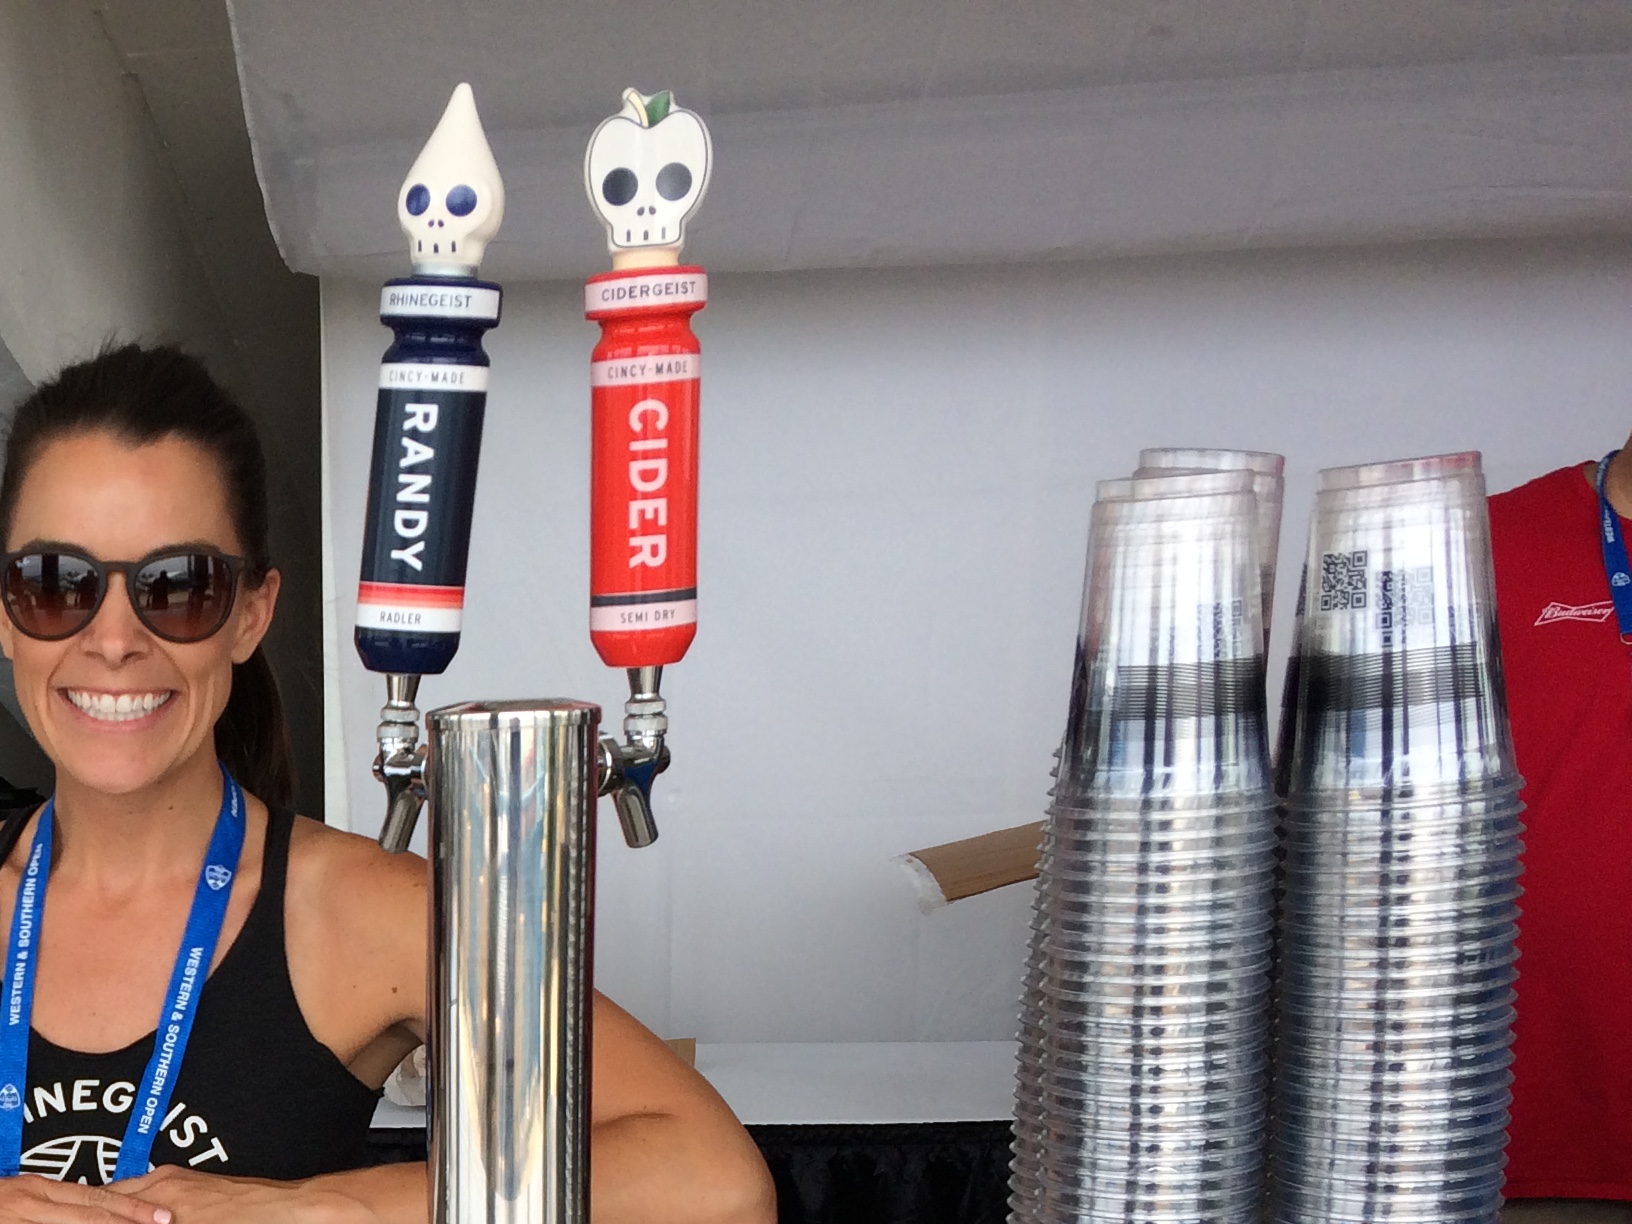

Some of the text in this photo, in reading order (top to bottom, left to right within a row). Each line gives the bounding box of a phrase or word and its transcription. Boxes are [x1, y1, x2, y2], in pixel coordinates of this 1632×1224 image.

[389, 293, 472, 308] RHINEGEIST
[601, 281, 696, 302] CIDERGEIST
[389, 370, 465, 385] CINCY-MADE
[607, 360, 688, 379] CINCY-MADE
[390, 403, 439, 572] RANDY
[628, 398, 669, 569] CIDER
[379, 611, 422, 625] RADLER
[620, 609, 676, 624] SEMI DRY
[9, 843, 43, 1026] WESTERN & SOUTHERN OPEN
[137, 947, 204, 1135] WESTERN & SOUTHERN OPEN
